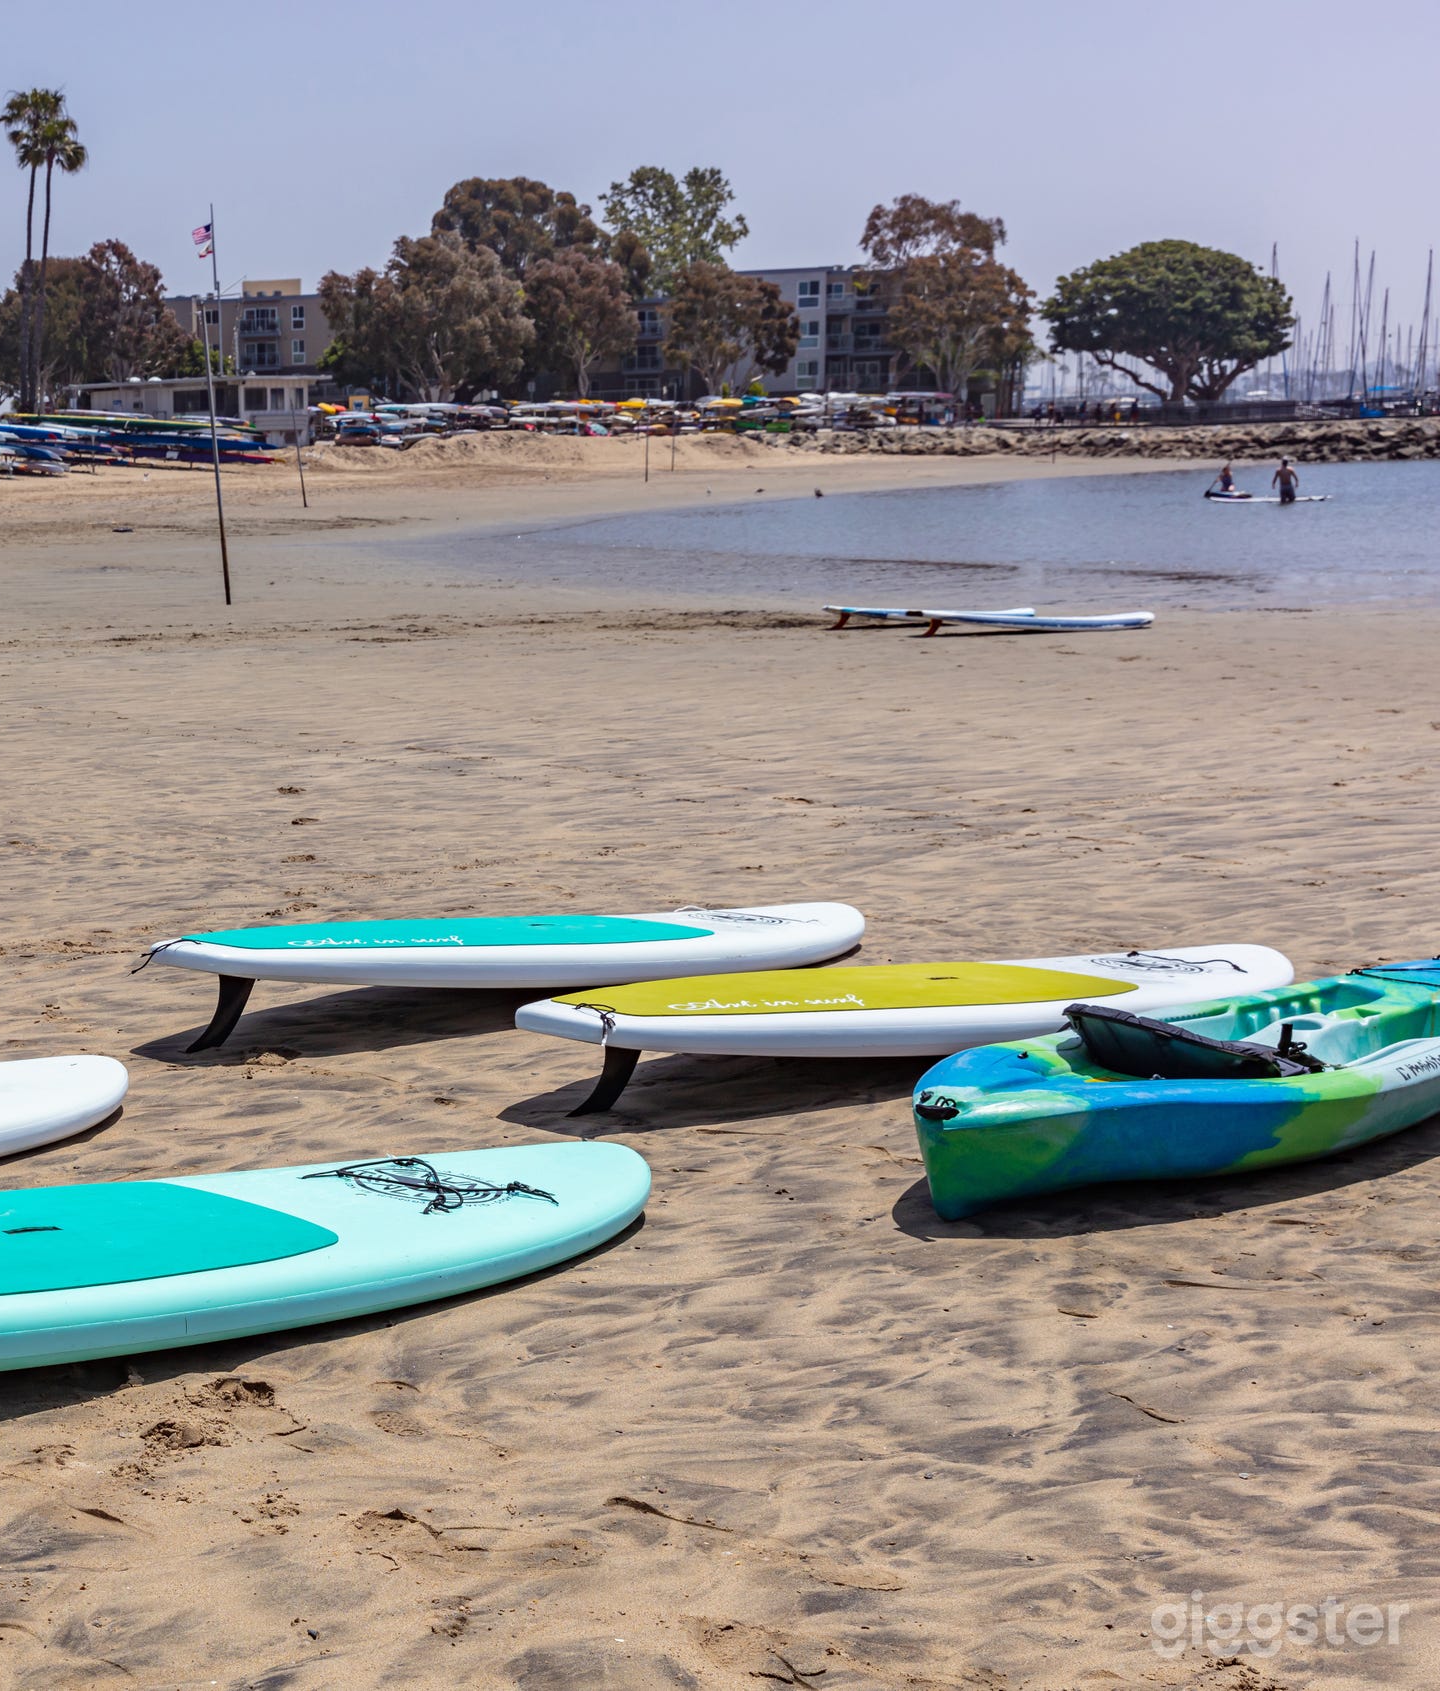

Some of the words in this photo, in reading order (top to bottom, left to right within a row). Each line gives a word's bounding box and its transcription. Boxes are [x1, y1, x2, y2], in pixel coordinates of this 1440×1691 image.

[288, 937, 367, 947] Art
[411, 935, 464, 946] surf
[667, 999, 758, 1011] Art
[762, 999, 800, 1007] in
[804, 993, 865, 1007] surf
